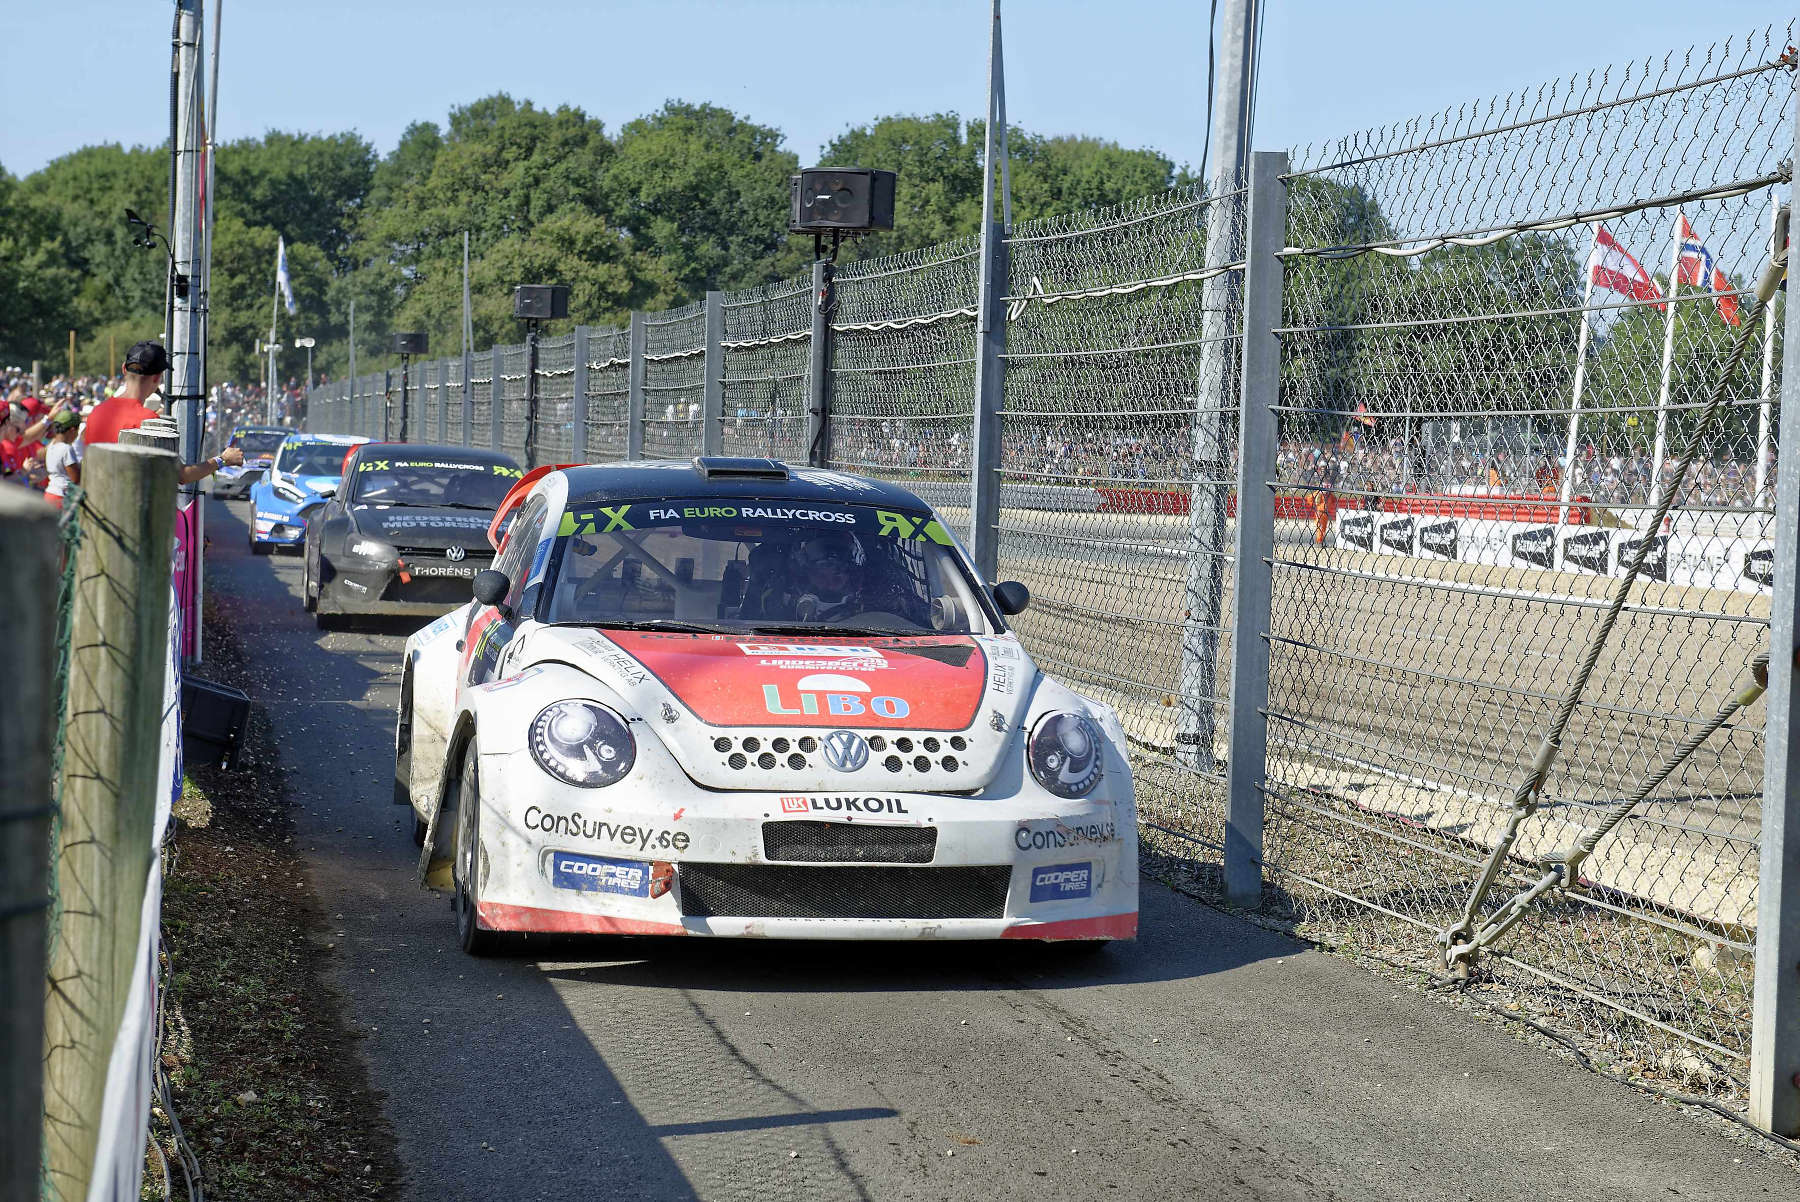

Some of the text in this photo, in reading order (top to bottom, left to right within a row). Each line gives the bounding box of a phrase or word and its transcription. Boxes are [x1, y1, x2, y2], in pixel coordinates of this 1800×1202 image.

[434, 462, 484, 471] RALLYCROSS
[650, 507, 856, 524] FIA EURO RALLYCROSS
[415, 566, 471, 576] THORÉNS
[609, 653, 651, 684] HELIX
[992, 663, 1007, 693] HELIX
[810, 797, 909, 814] LUKOIL
[524, 805, 691, 851] ConSurvey.se
[559, 860, 643, 880] COOPER
[1035, 869, 1089, 886] COOPER
[600, 876, 640, 889] TIRES
[1060, 880, 1087, 891] TIRES
